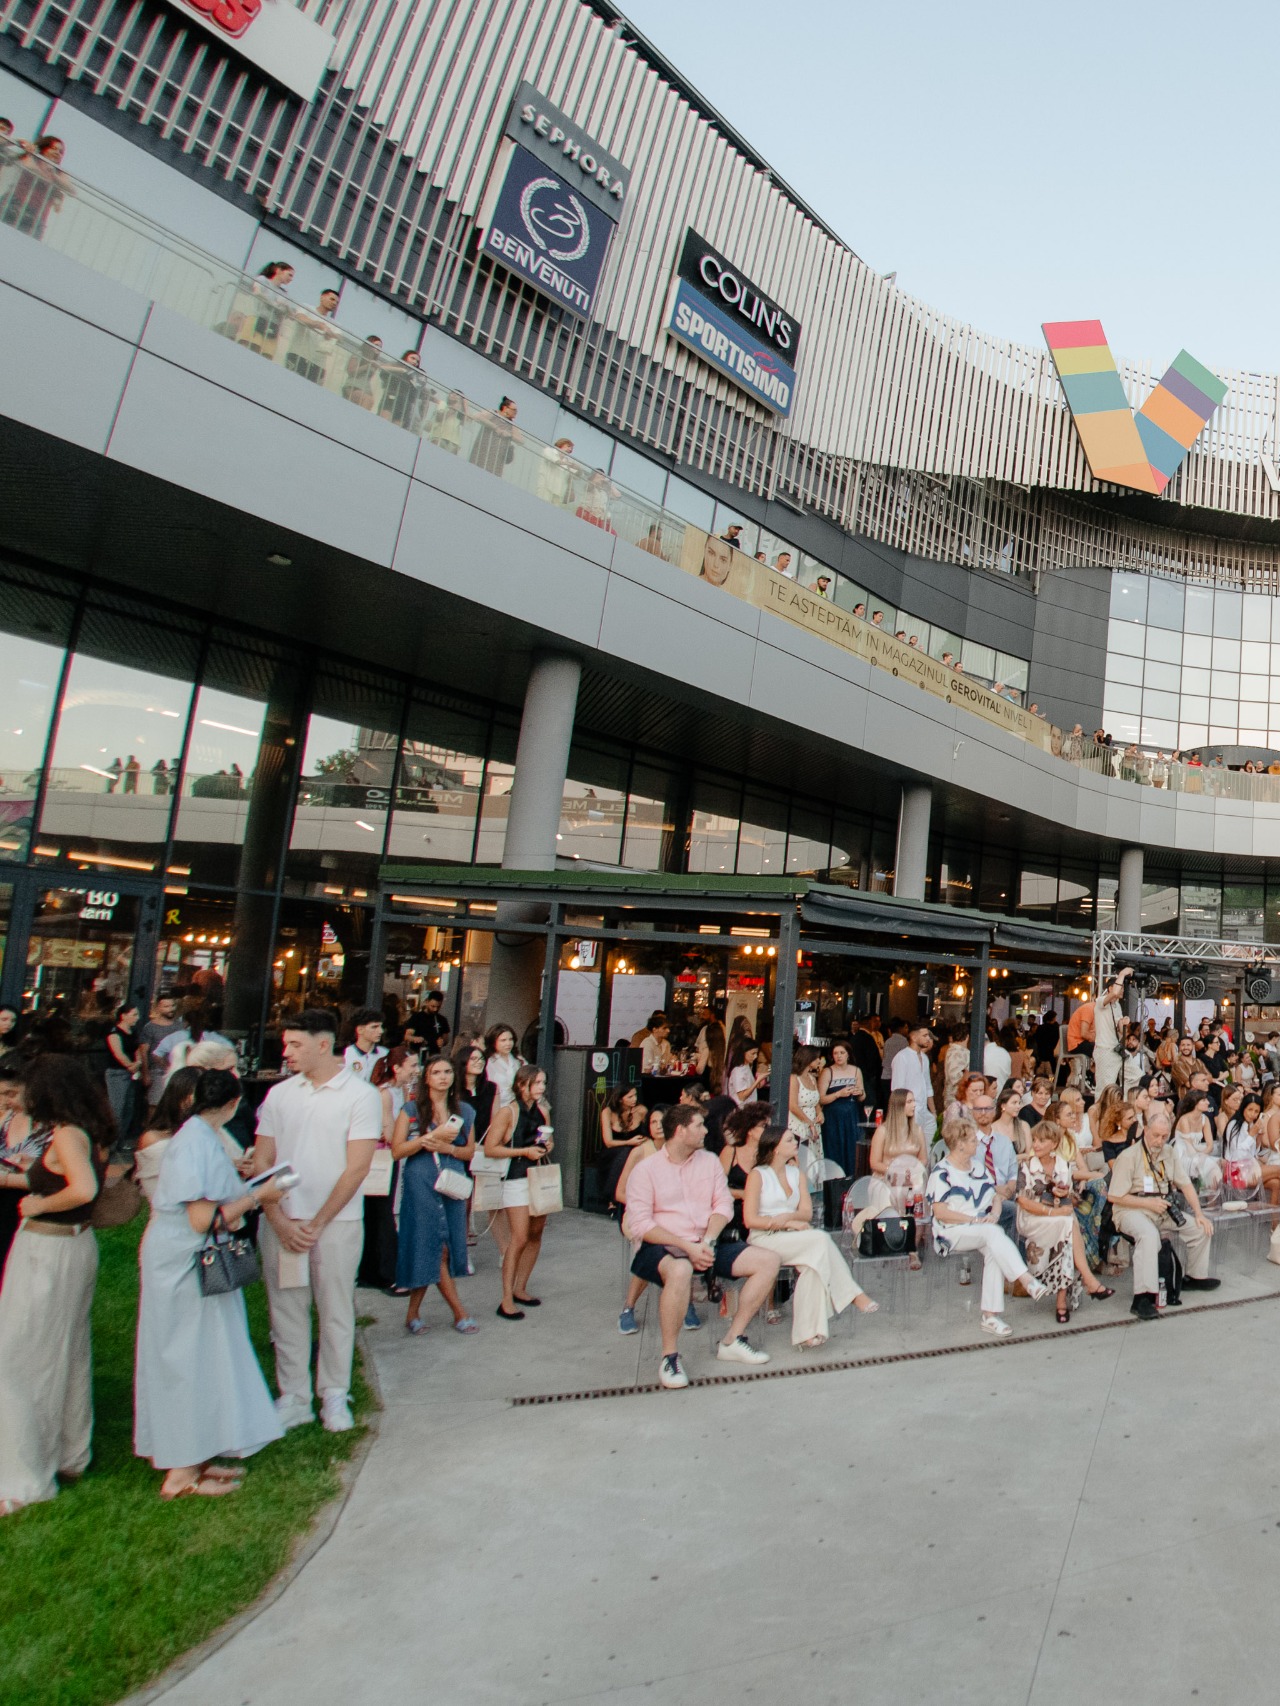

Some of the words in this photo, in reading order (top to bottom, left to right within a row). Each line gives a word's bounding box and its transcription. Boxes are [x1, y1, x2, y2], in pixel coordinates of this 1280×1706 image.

[520, 104, 624, 200] SEPHORA
[490, 228, 590, 311] BENVENUTI
[700, 255, 792, 349] COLIN'S
[675, 302, 791, 408] SPORTISIMO
[769, 579, 787, 603] TE
[866, 630, 880, 651] ÎN
[882, 642, 949, 688] MAGAZINUL
[950, 678, 1001, 714] GEROVITAL
[1003, 706, 1028, 730] NIVEL
